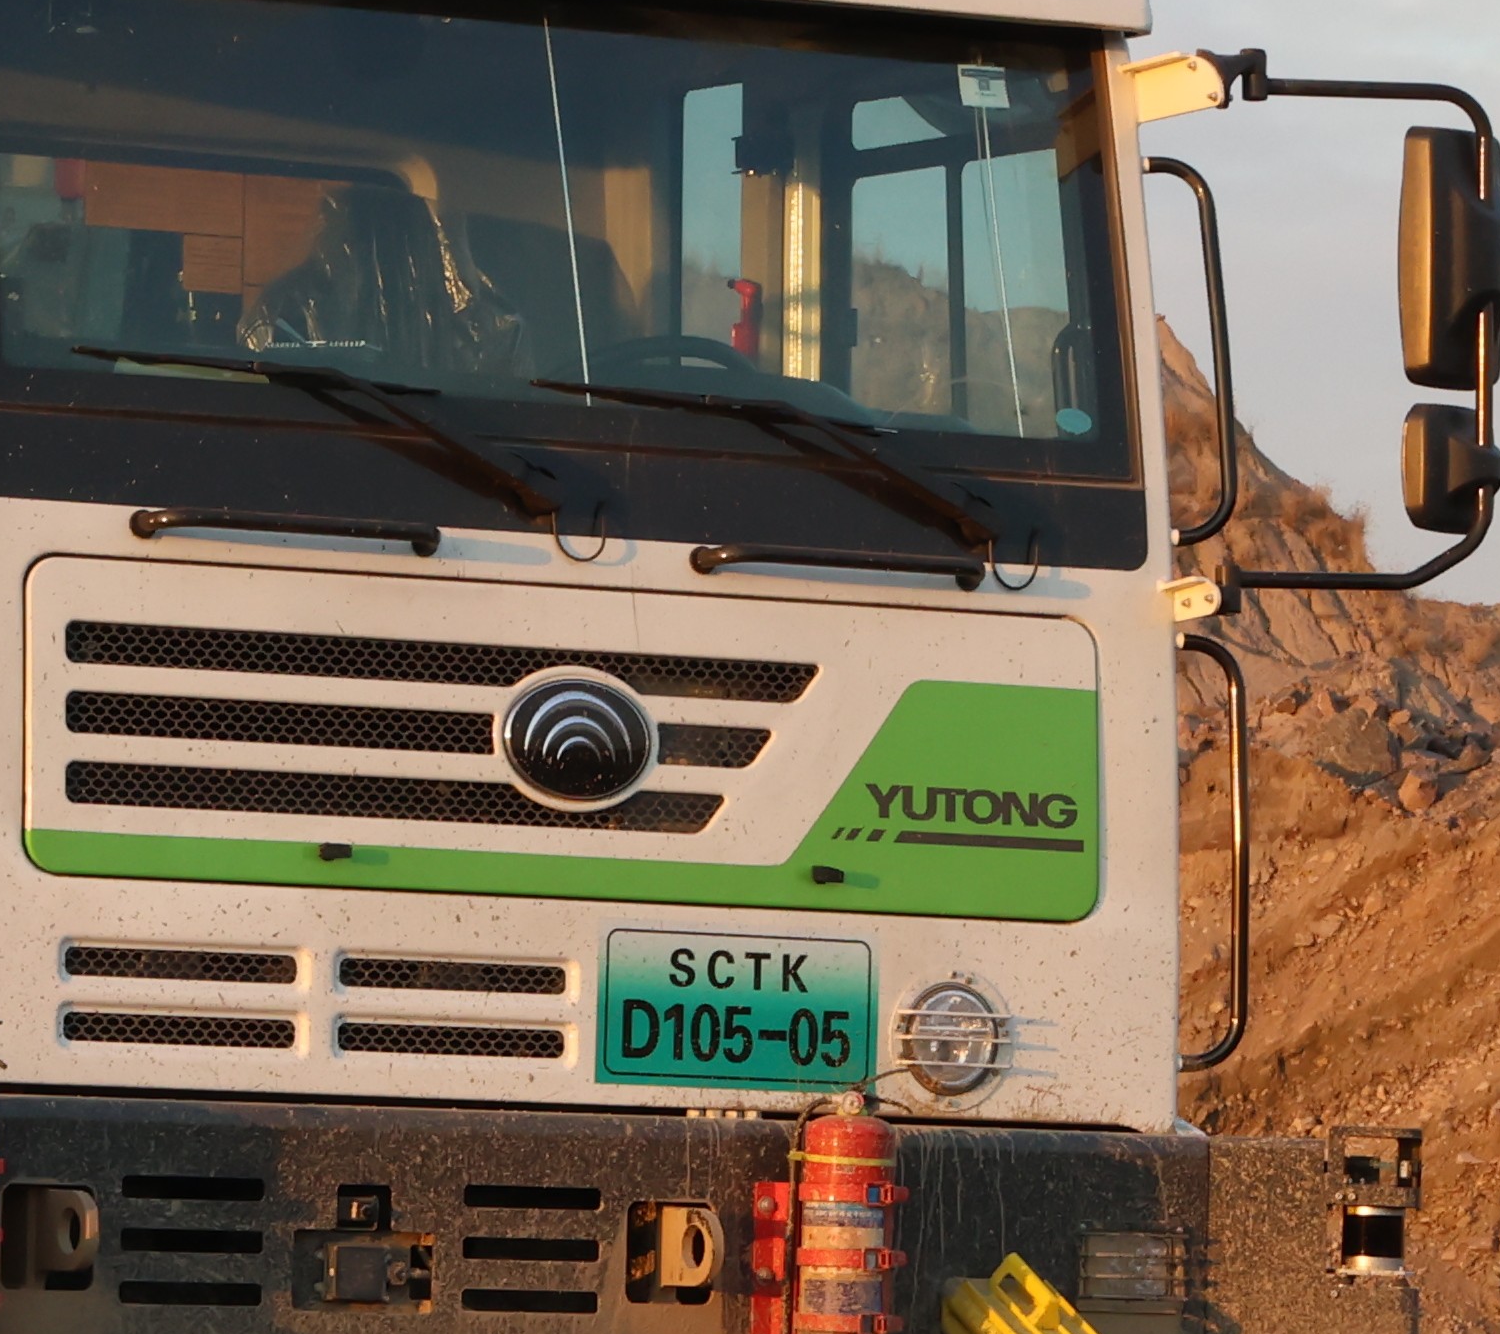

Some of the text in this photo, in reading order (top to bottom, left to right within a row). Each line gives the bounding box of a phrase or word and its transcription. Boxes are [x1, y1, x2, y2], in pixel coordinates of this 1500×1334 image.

[865, 783, 1078, 829] YUTONG
[669, 948, 809, 993] SCTK
[621, 999, 850, 1068] D105-05
